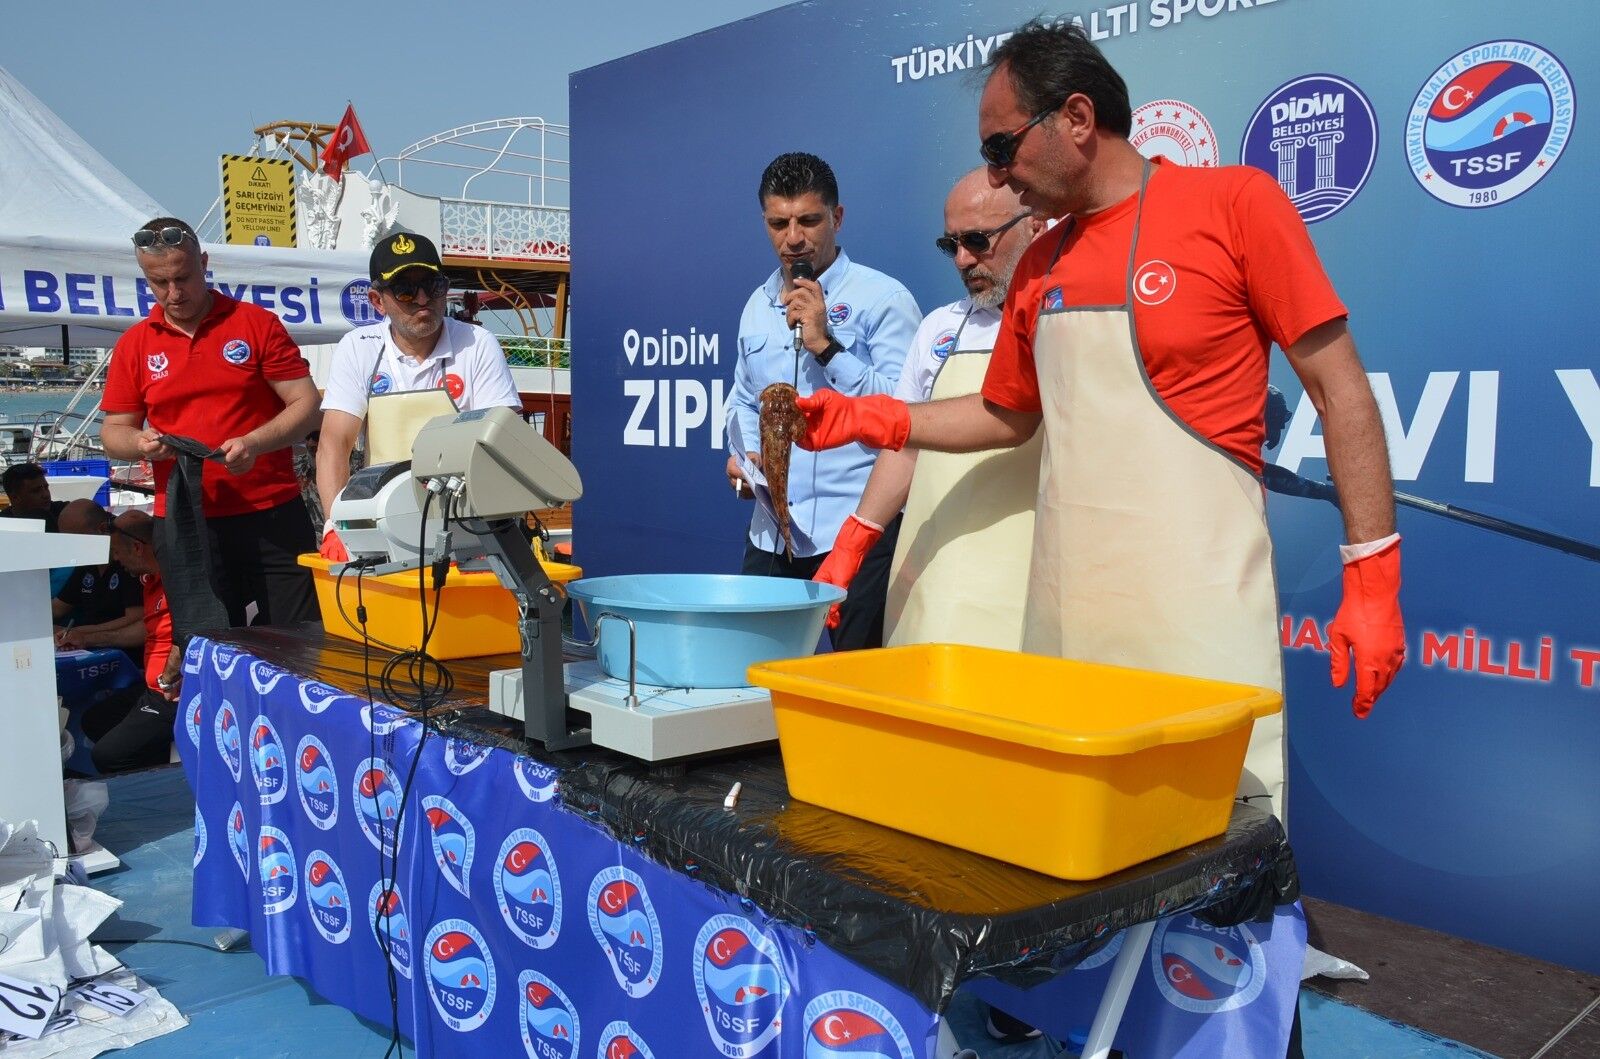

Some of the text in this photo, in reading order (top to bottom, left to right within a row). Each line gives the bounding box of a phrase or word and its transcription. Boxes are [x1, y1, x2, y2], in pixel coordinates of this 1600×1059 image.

[1270, 92, 1345, 125] DİDİM
[1417, 63, 1458, 109] SUALTI
[1463, 45, 1536, 66] SPORLARI
[1535, 56, 1571, 159] FEDERASYONU
[1272, 115, 1344, 138] BELEDİYESİ
[1450, 151, 1522, 177] TSSF
[236, 191, 255, 199] SARI
[1469, 190, 1498, 204] 1980
[242, 224, 266, 232] YELLOW
[643, 327, 719, 367] DİDİM
[1422, 628, 1552, 681] MİLLİ
[78, 660, 120, 680] TSSF
[318, 909, 340, 928] TSSF
[515, 906, 544, 930] TSSF
[440, 989, 474, 1012] TSSF
[716, 1005, 760, 1034] TSSF
[722, 1043, 744, 1057] 1980
